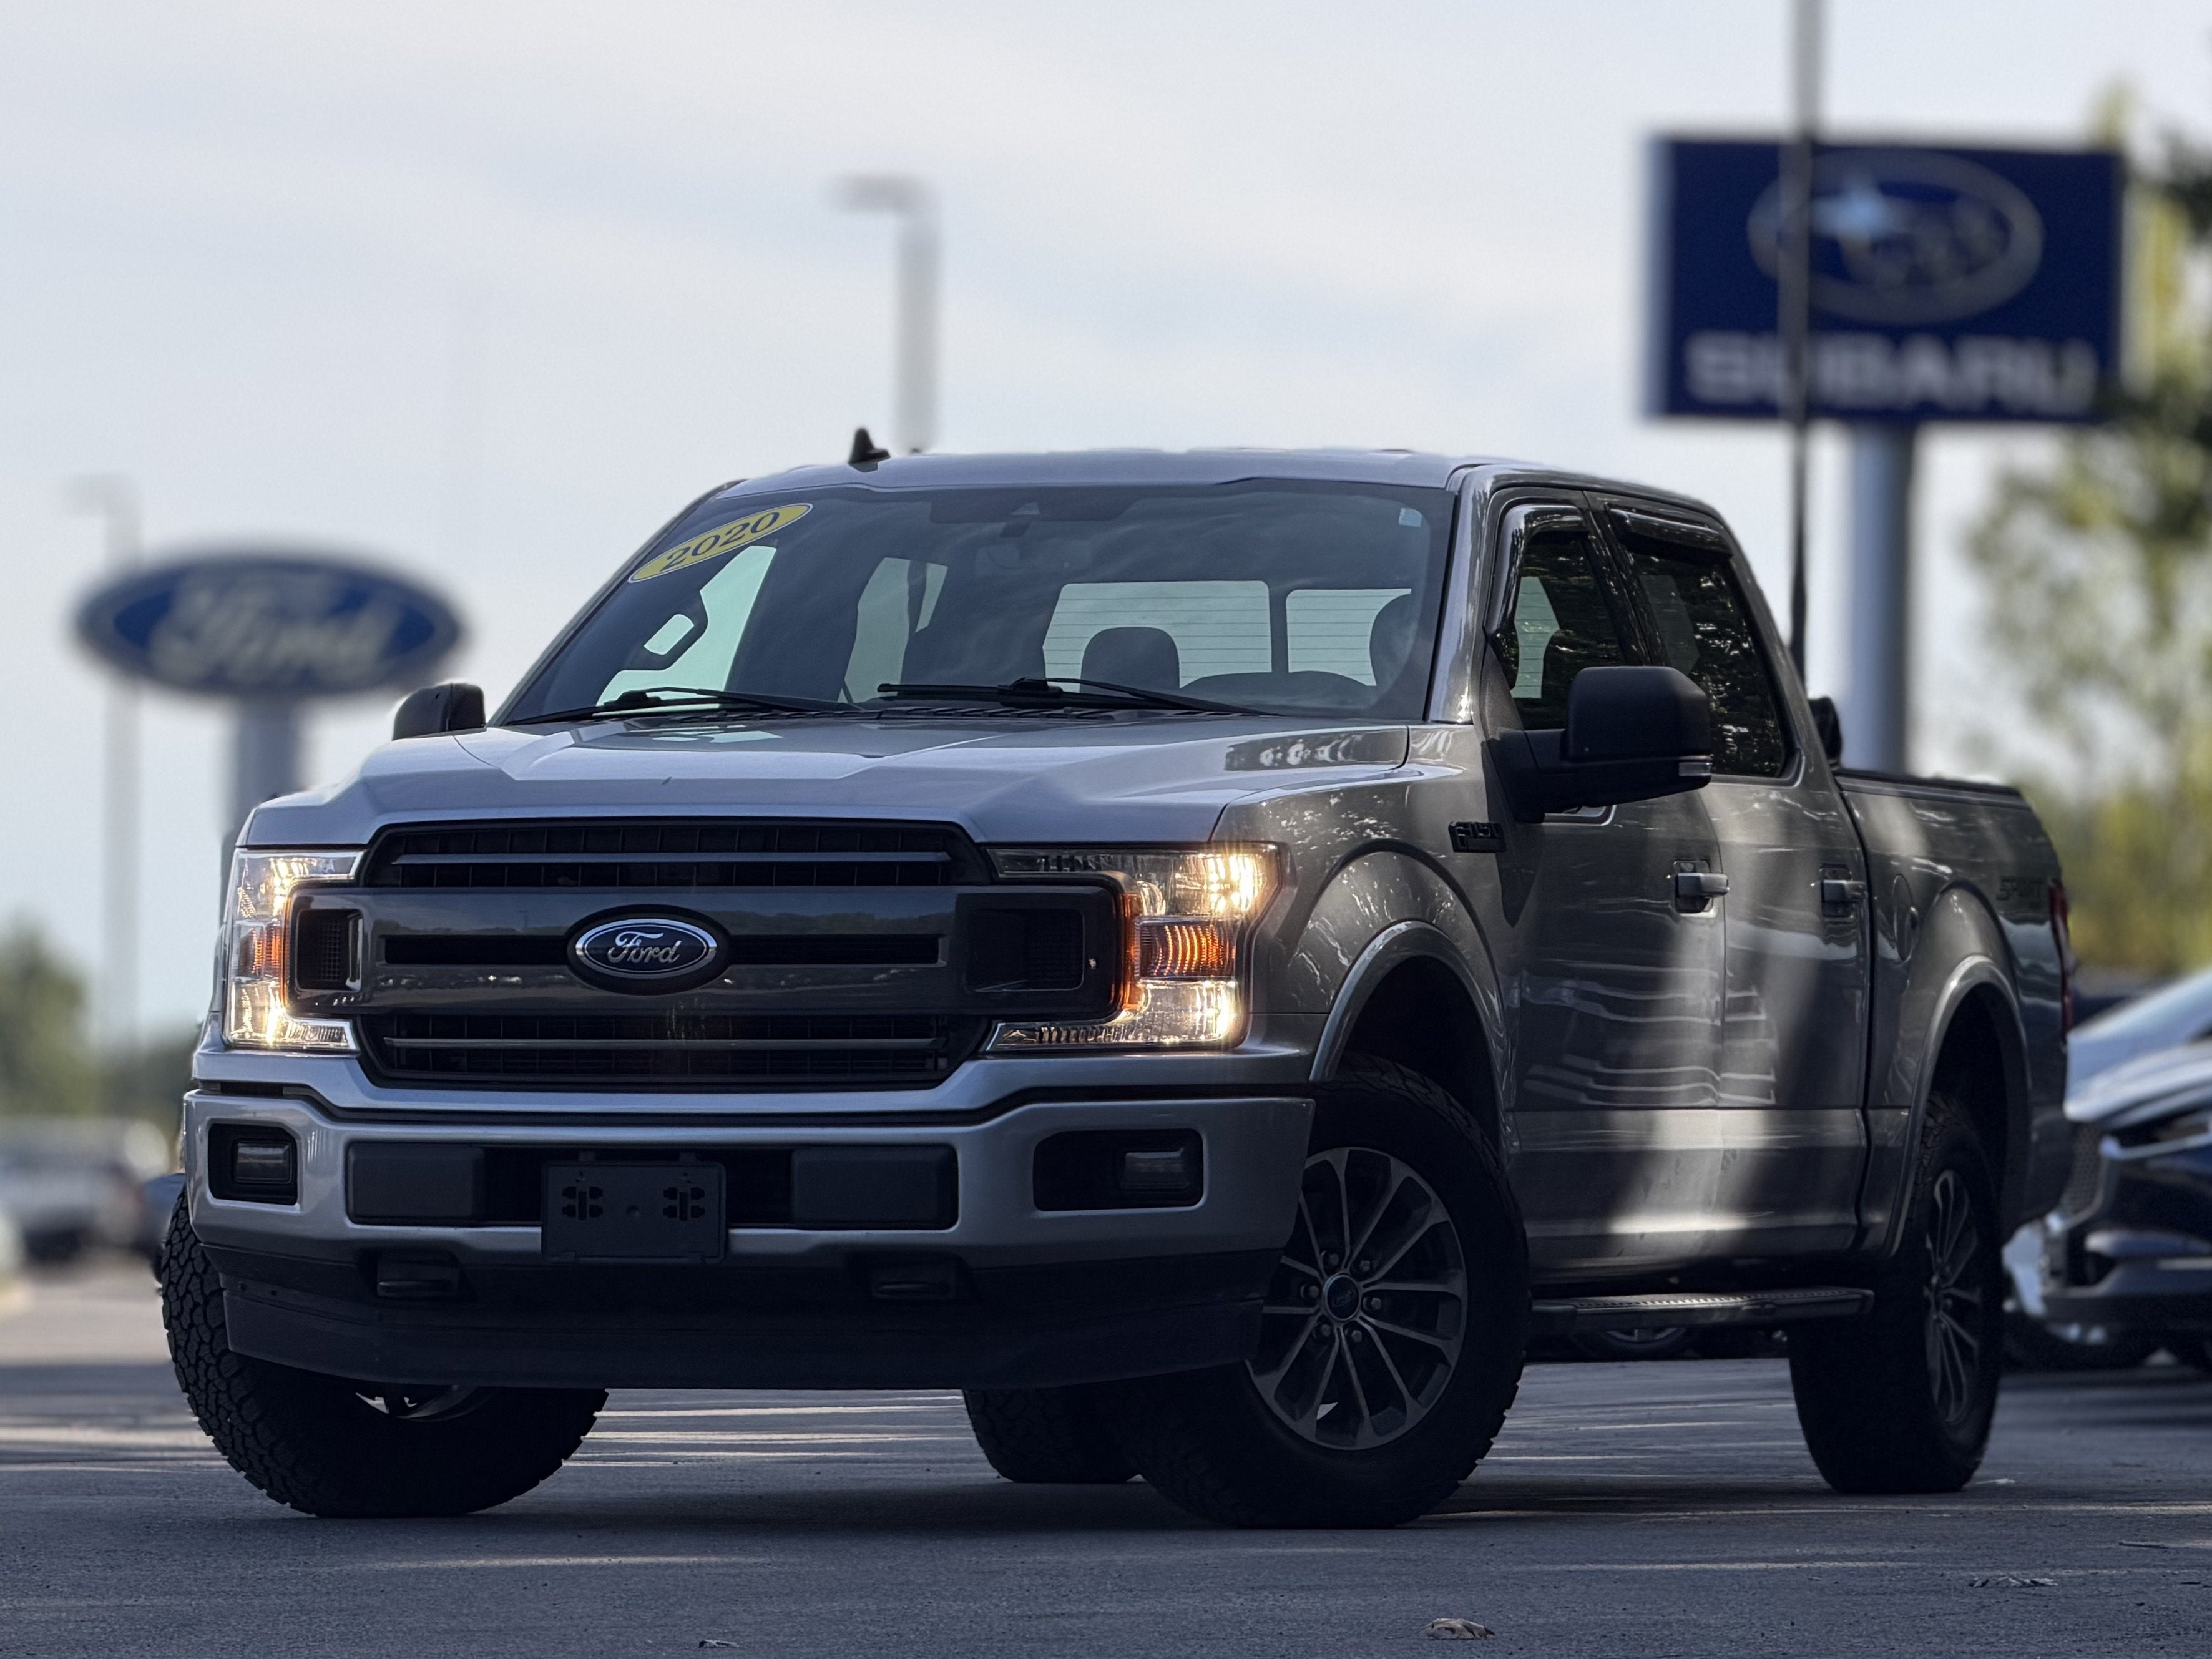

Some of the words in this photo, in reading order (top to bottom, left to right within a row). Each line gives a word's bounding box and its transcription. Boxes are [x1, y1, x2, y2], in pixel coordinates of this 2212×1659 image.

[659, 512, 780, 572] 2020
[149, 569, 404, 684] Ford
[607, 931, 682, 964] Ford
